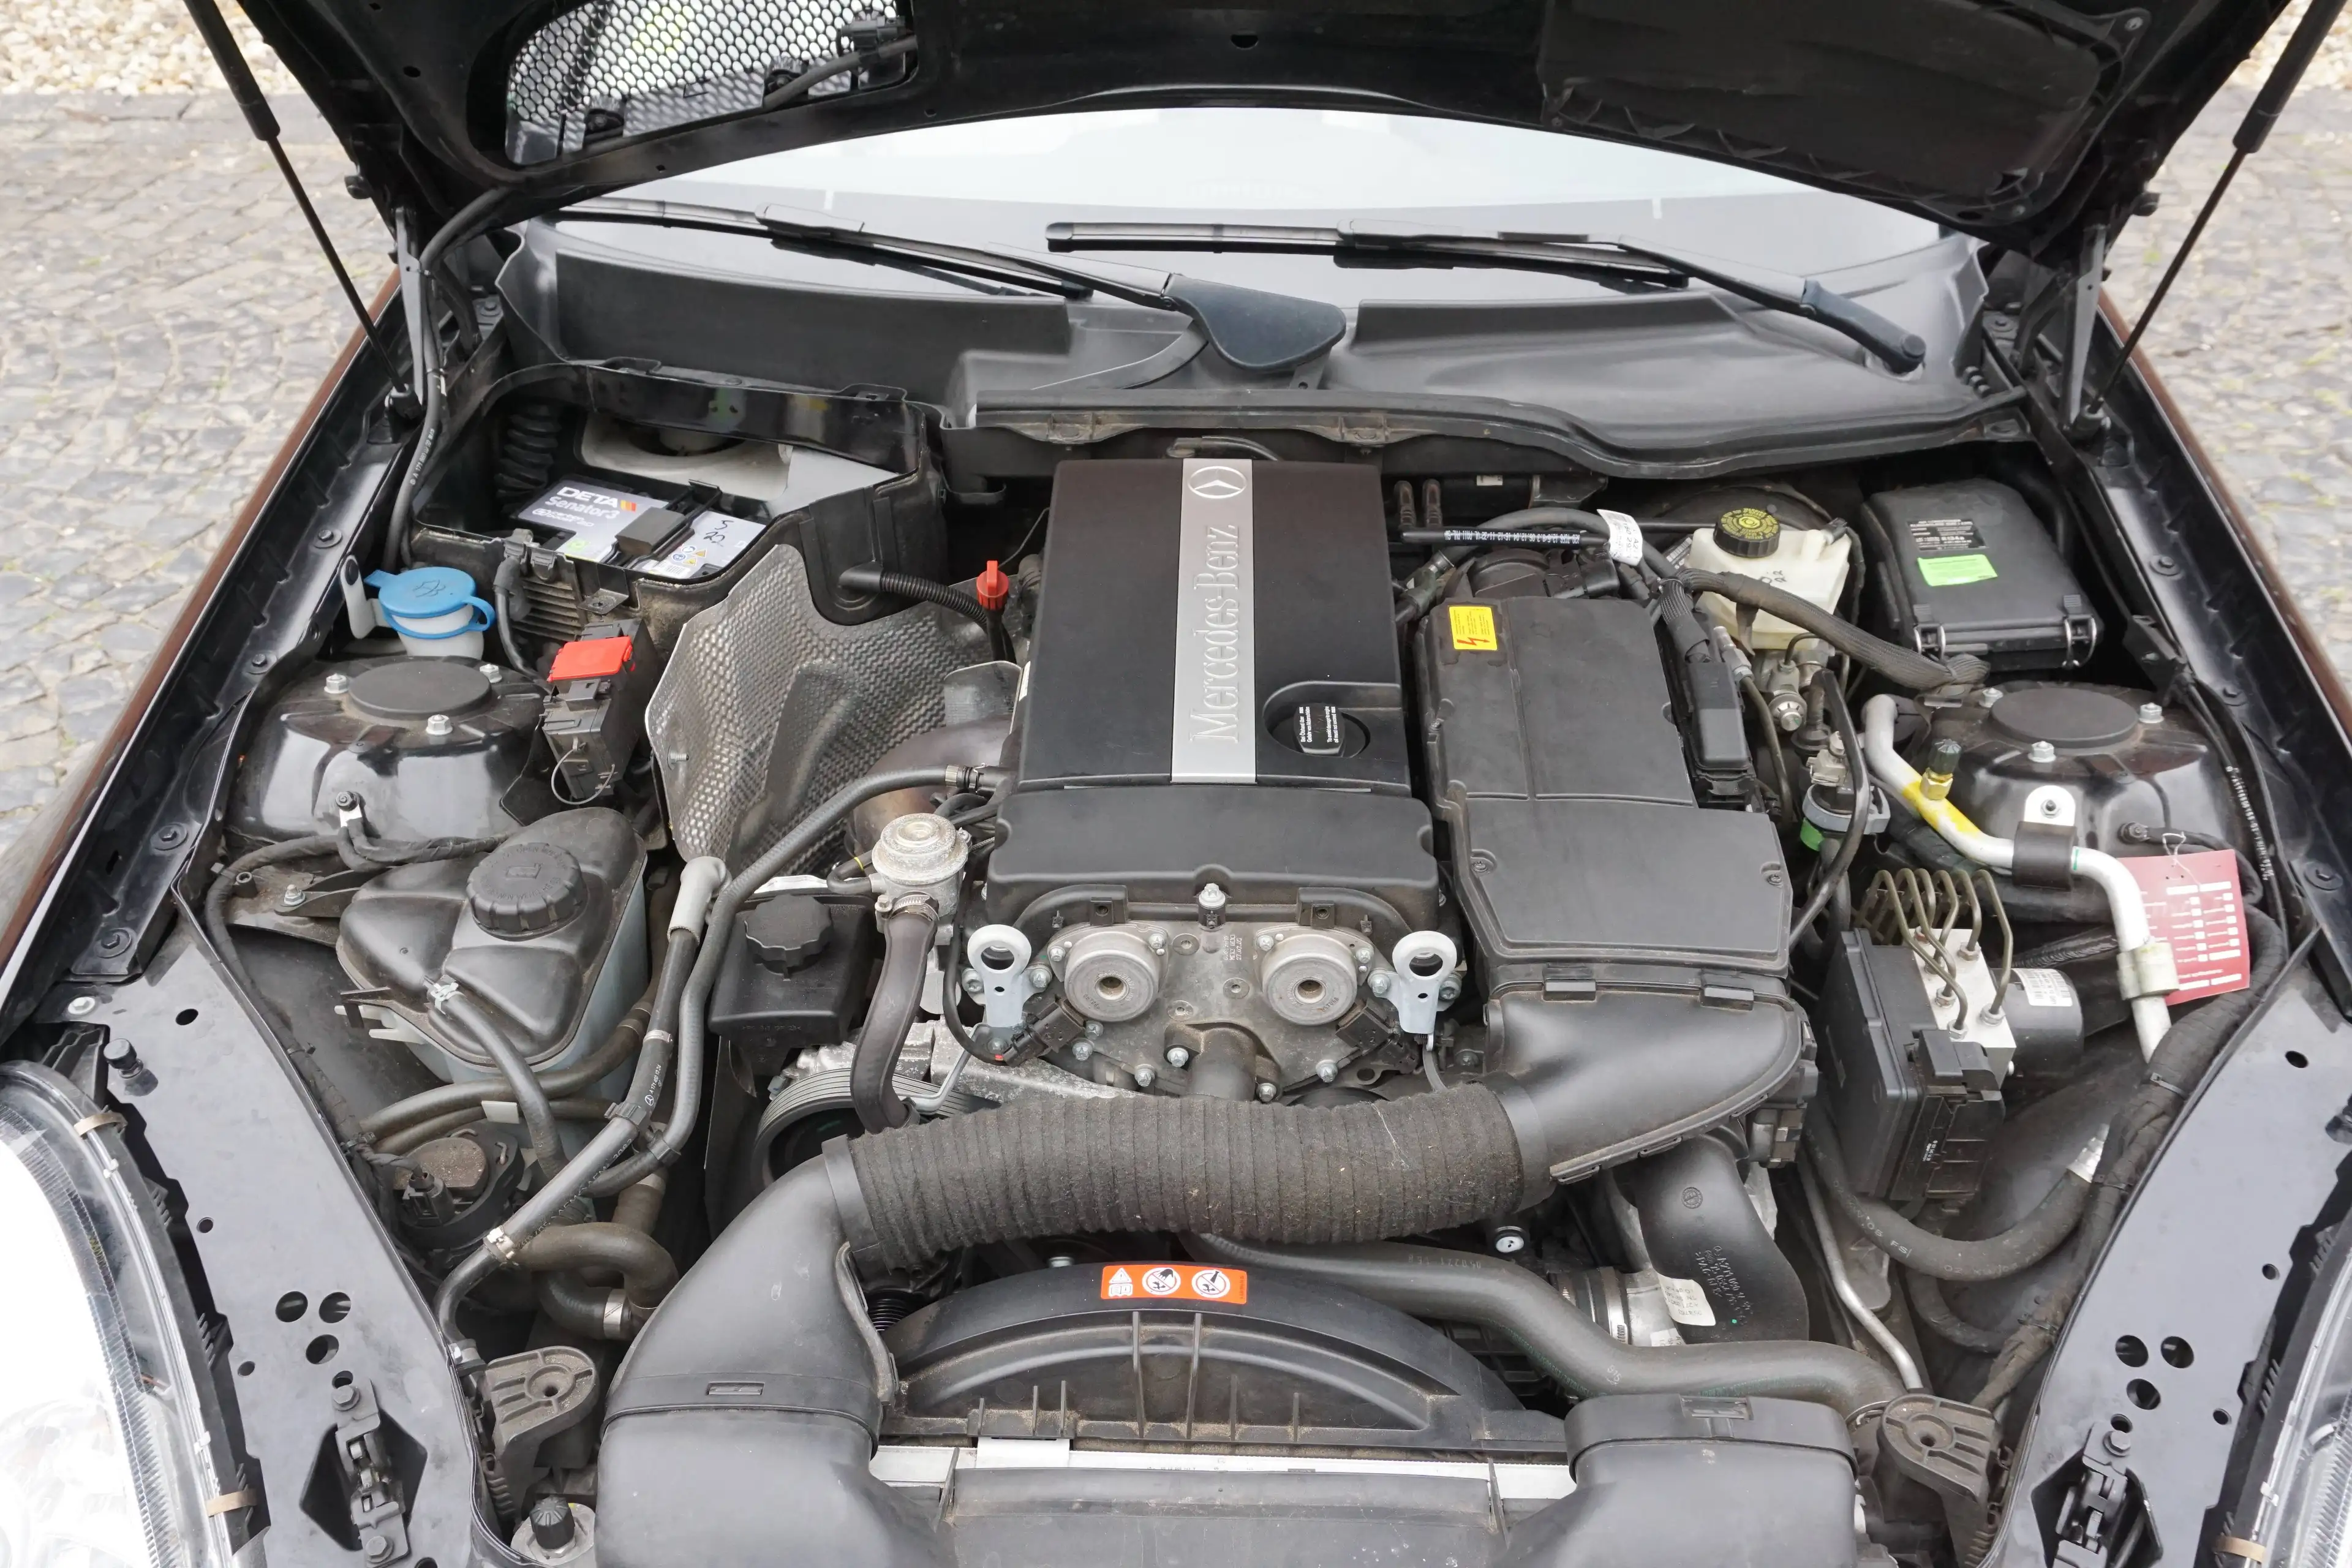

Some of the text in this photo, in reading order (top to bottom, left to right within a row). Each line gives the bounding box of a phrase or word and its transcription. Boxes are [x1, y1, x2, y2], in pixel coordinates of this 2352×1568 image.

[545, 496, 620, 519] Senator3
[557, 486, 619, 508] DETA
[1189, 525, 1239, 743] Mercedes-Benz
